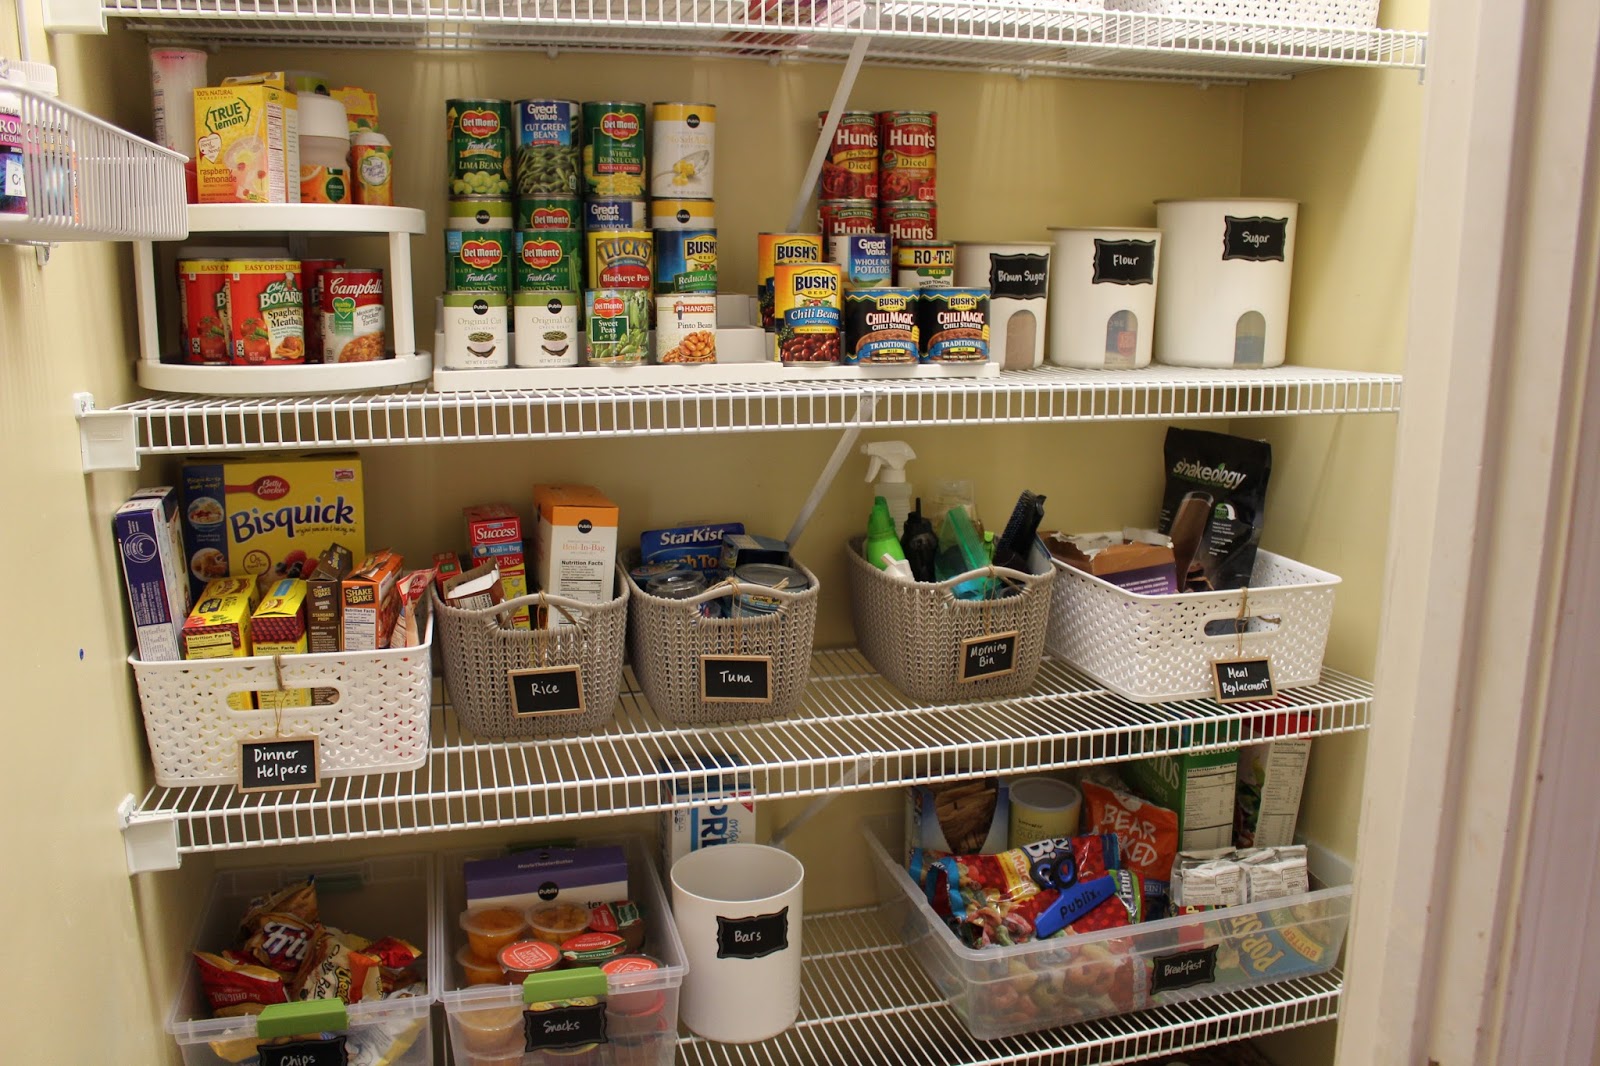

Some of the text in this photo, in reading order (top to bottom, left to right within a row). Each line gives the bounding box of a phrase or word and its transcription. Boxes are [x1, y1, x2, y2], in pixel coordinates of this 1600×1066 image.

[210, 102, 242, 122] TRUE
[528, 104, 558, 116] Great
[215, 115, 244, 130] lemon
[463, 119, 498, 127] Del Monte
[525, 124, 540, 132] CUT
[604, 121, 638, 129] Del Monte
[533, 131, 558, 139] BEANS
[837, 129, 878, 147] Hunt's
[890, 129, 935, 149] Hunt's
[459, 161, 502, 170] LIMA BEANS
[848, 162, 872, 170] Diced
[901, 158, 928, 167] Diced
[200, 166, 232, 176] raspberry
[204, 175, 237, 183] lemonade
[591, 204, 619, 215] Great
[534, 216, 569, 224] Del Monte
[890, 224, 934, 240] Hunt's
[858, 239, 886, 250] Great
[1242, 231, 1270, 248] Sugar
[477, 249, 501, 257] Monte
[524, 249, 560, 257] Del Monte
[603, 239, 650, 259] LUCK'S
[777, 246, 817, 261] BUSH'S
[866, 248, 886, 256] Value
[1113, 254, 1140, 267] Flour
[855, 266, 890, 274] POTATOES
[466, 273, 498, 283] Fresh Cut
[526, 273, 557, 283] Fresh Cut
[603, 274, 650, 284] Blackeye Peas
[678, 273, 708, 285] Reduced
[998, 270, 1046, 285] Brown Sugar
[795, 276, 837, 292] BUSH'S
[879, 298, 904, 307] BUSH'S
[950, 298, 975, 307] BUSH'S
[684, 305, 714, 313] HANOVER
[791, 309, 839, 321] Chili Beans
[458, 318, 488, 326] Original
[532, 317, 563, 325] Original
[866, 312, 914, 326] CHILI MAGIC
[937, 311, 985, 324] CHILI MAGIC
[960, 322, 982, 330] STARTER
[870, 342, 911, 350] TRADITIONAL
[941, 340, 981, 348] TRADITIONAL
[1173, 458, 1246, 490] shakeology
[263, 479, 282, 489] Betty
[257, 486, 285, 496] Crocker
[230, 496, 354, 544] Bisquick
[477, 528, 516, 541] Success
[660, 527, 725, 546] StarKist
[504, 557, 520, 566] Rice
[346, 588, 373, 597] SHAKE
[352, 595, 374, 604] BAKE
[970, 642, 1007, 658] Morning
[979, 655, 995, 667] Bin
[719, 671, 753, 684] Tuna
[1228, 667, 1248, 679] Meal
[532, 682, 560, 696] Rice
[1222, 678, 1270, 696] Replacement
[254, 747, 299, 763] Dinner
[257, 764, 308, 782] Helpers
[1101, 804, 1157, 844] BEAR
[518, 859, 574, 870] MovieTheaterButter
[735, 930, 762, 943] Bars
[1284, 927, 1319, 957] BUTTER
[1164, 957, 1205, 977] Breakfast
[543, 1020, 581, 1034] Snacks
[281, 1054, 316, 1066] Chips
